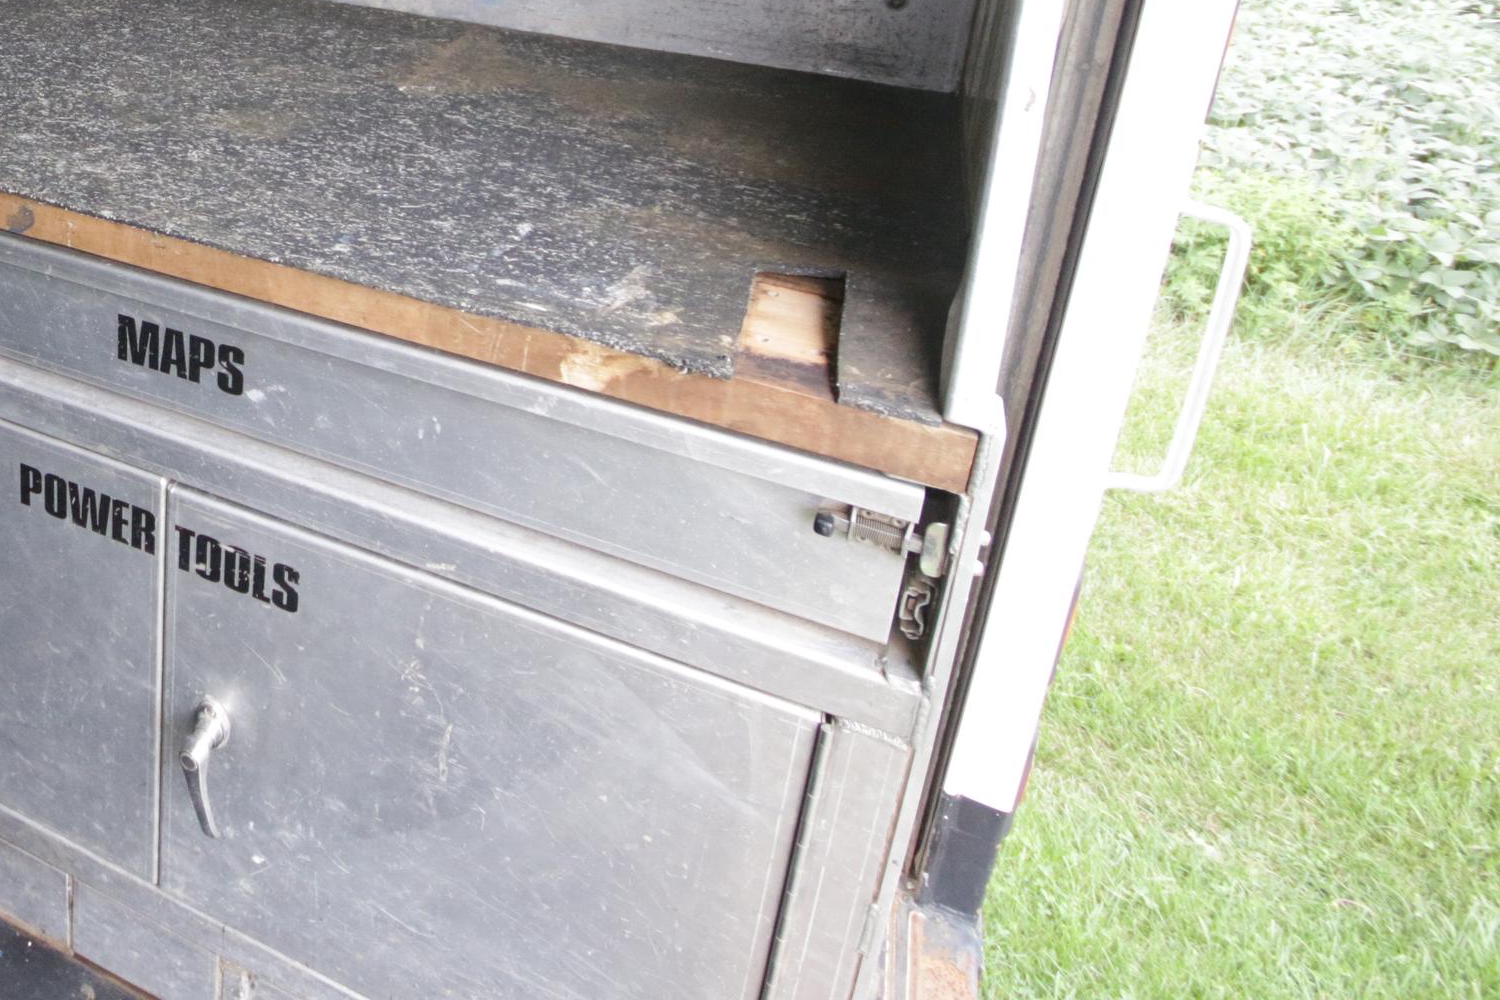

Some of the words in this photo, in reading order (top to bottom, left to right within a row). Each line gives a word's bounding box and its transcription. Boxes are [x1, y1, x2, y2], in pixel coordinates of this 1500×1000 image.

[117, 313, 245, 396] MAPS
[20, 463, 156, 555] POWER
[175, 524, 300, 613] TOOLS
